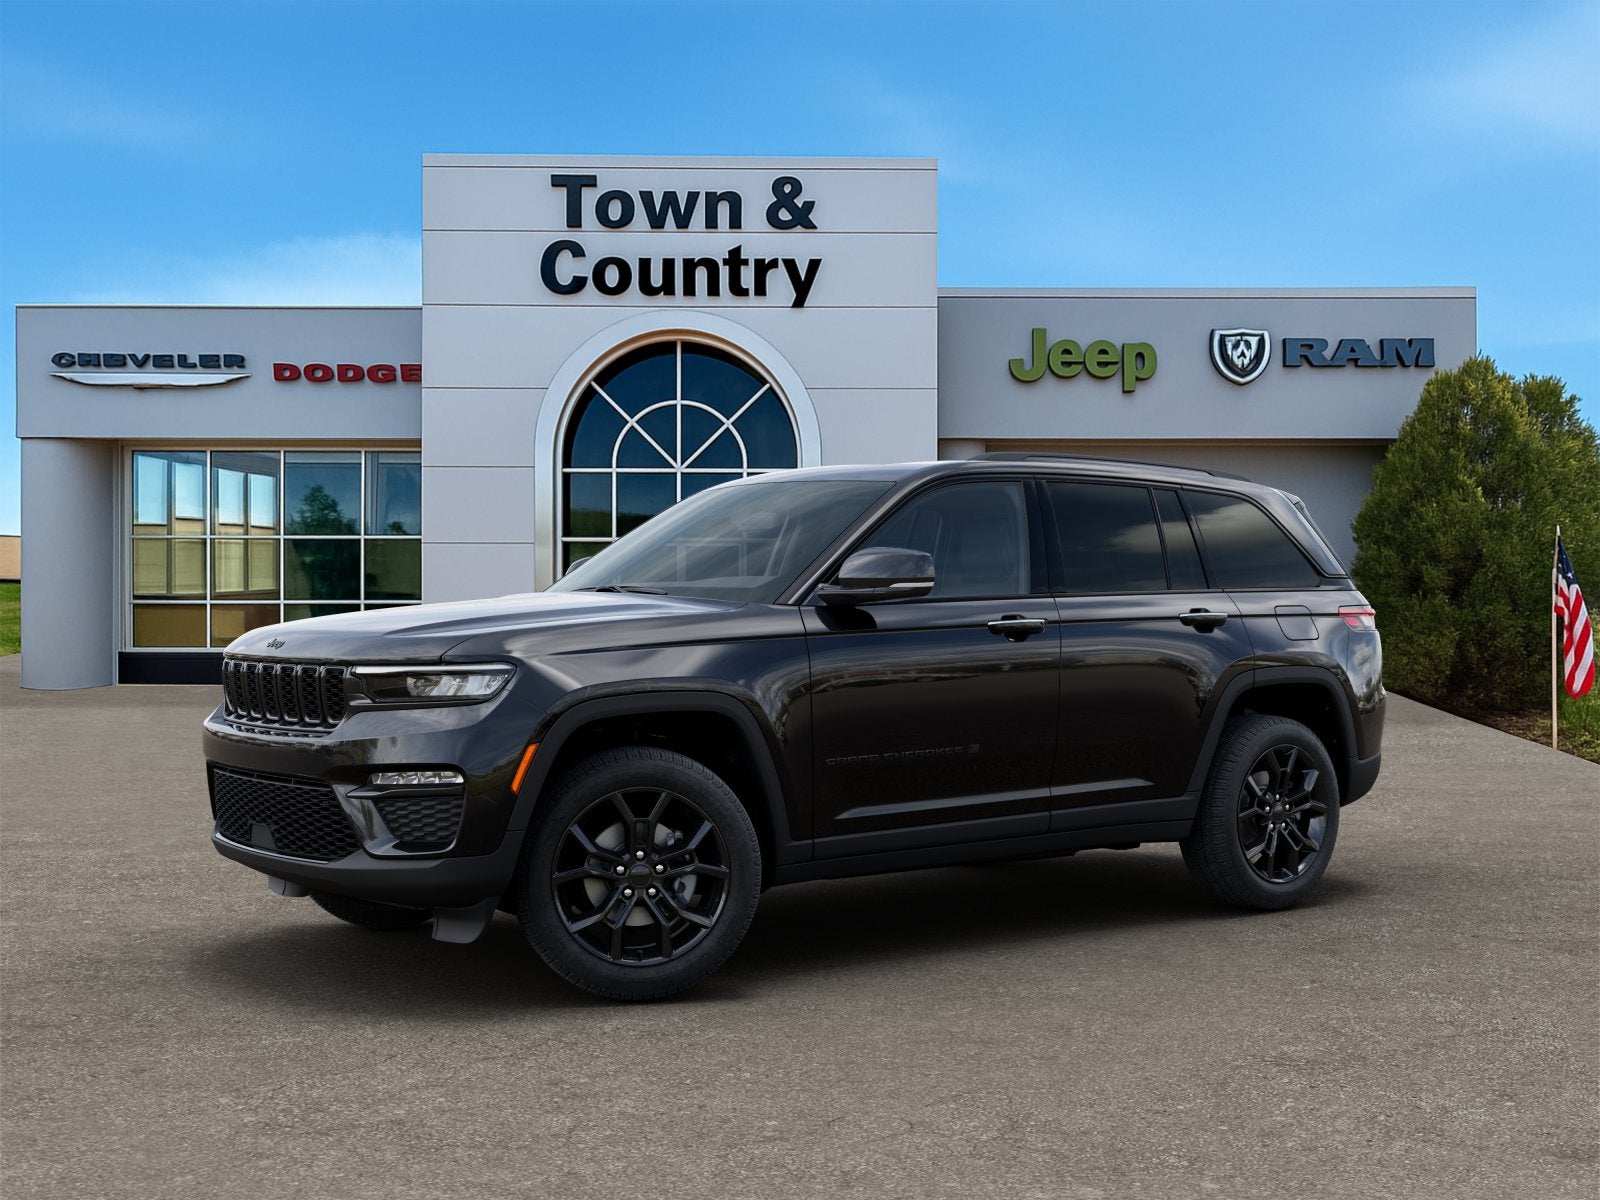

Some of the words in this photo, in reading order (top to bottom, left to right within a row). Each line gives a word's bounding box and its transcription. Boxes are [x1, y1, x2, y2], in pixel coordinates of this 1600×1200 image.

[551, 174, 742, 229] Town
[765, 176, 818, 230] &
[540, 240, 822, 308] Country
[273, 362, 422, 384] DODGE
[1008, 328, 1158, 393] Jeep
[1282, 338, 1436, 367] RAM
[825, 753, 880, 766] GRAND
